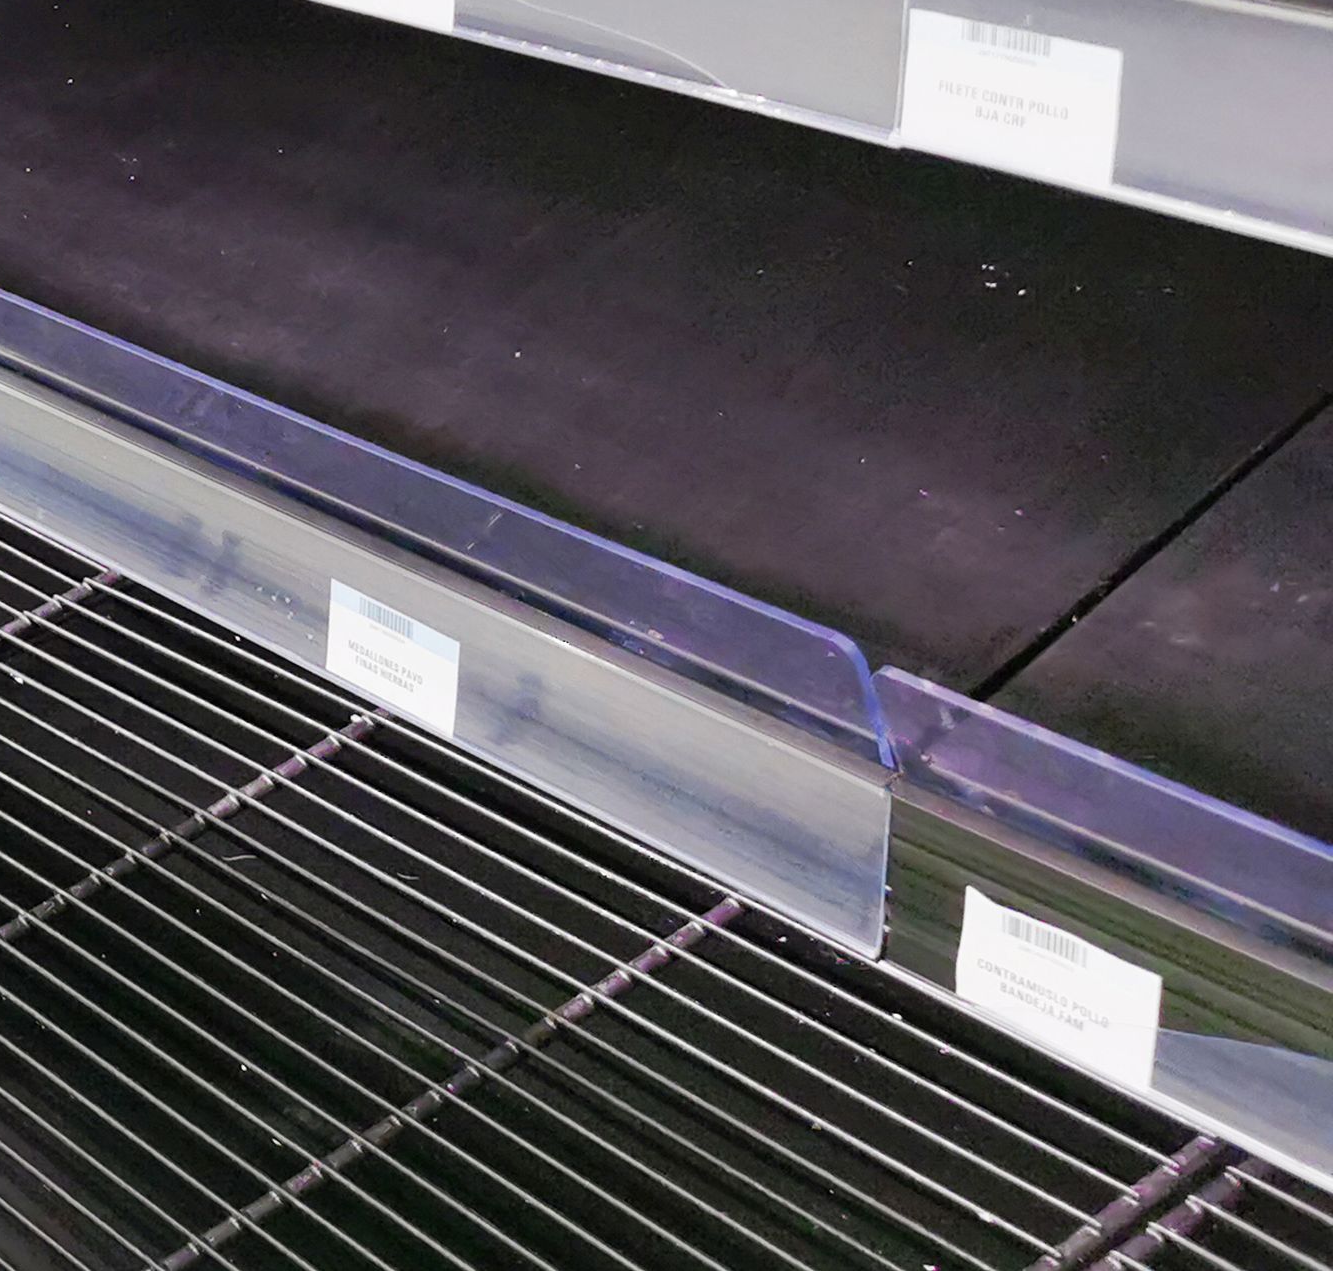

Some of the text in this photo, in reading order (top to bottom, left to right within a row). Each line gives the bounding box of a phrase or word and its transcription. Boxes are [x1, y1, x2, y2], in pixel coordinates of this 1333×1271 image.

[938, 80, 1069, 120] FILETE CONTR POLLO
[348, 639, 423, 686] MEDALLONES PAVO
[976, 957, 1110, 1029] CONTRAMUSLO POLLO
[999, 980, 1055, 1018] BANDEJA
